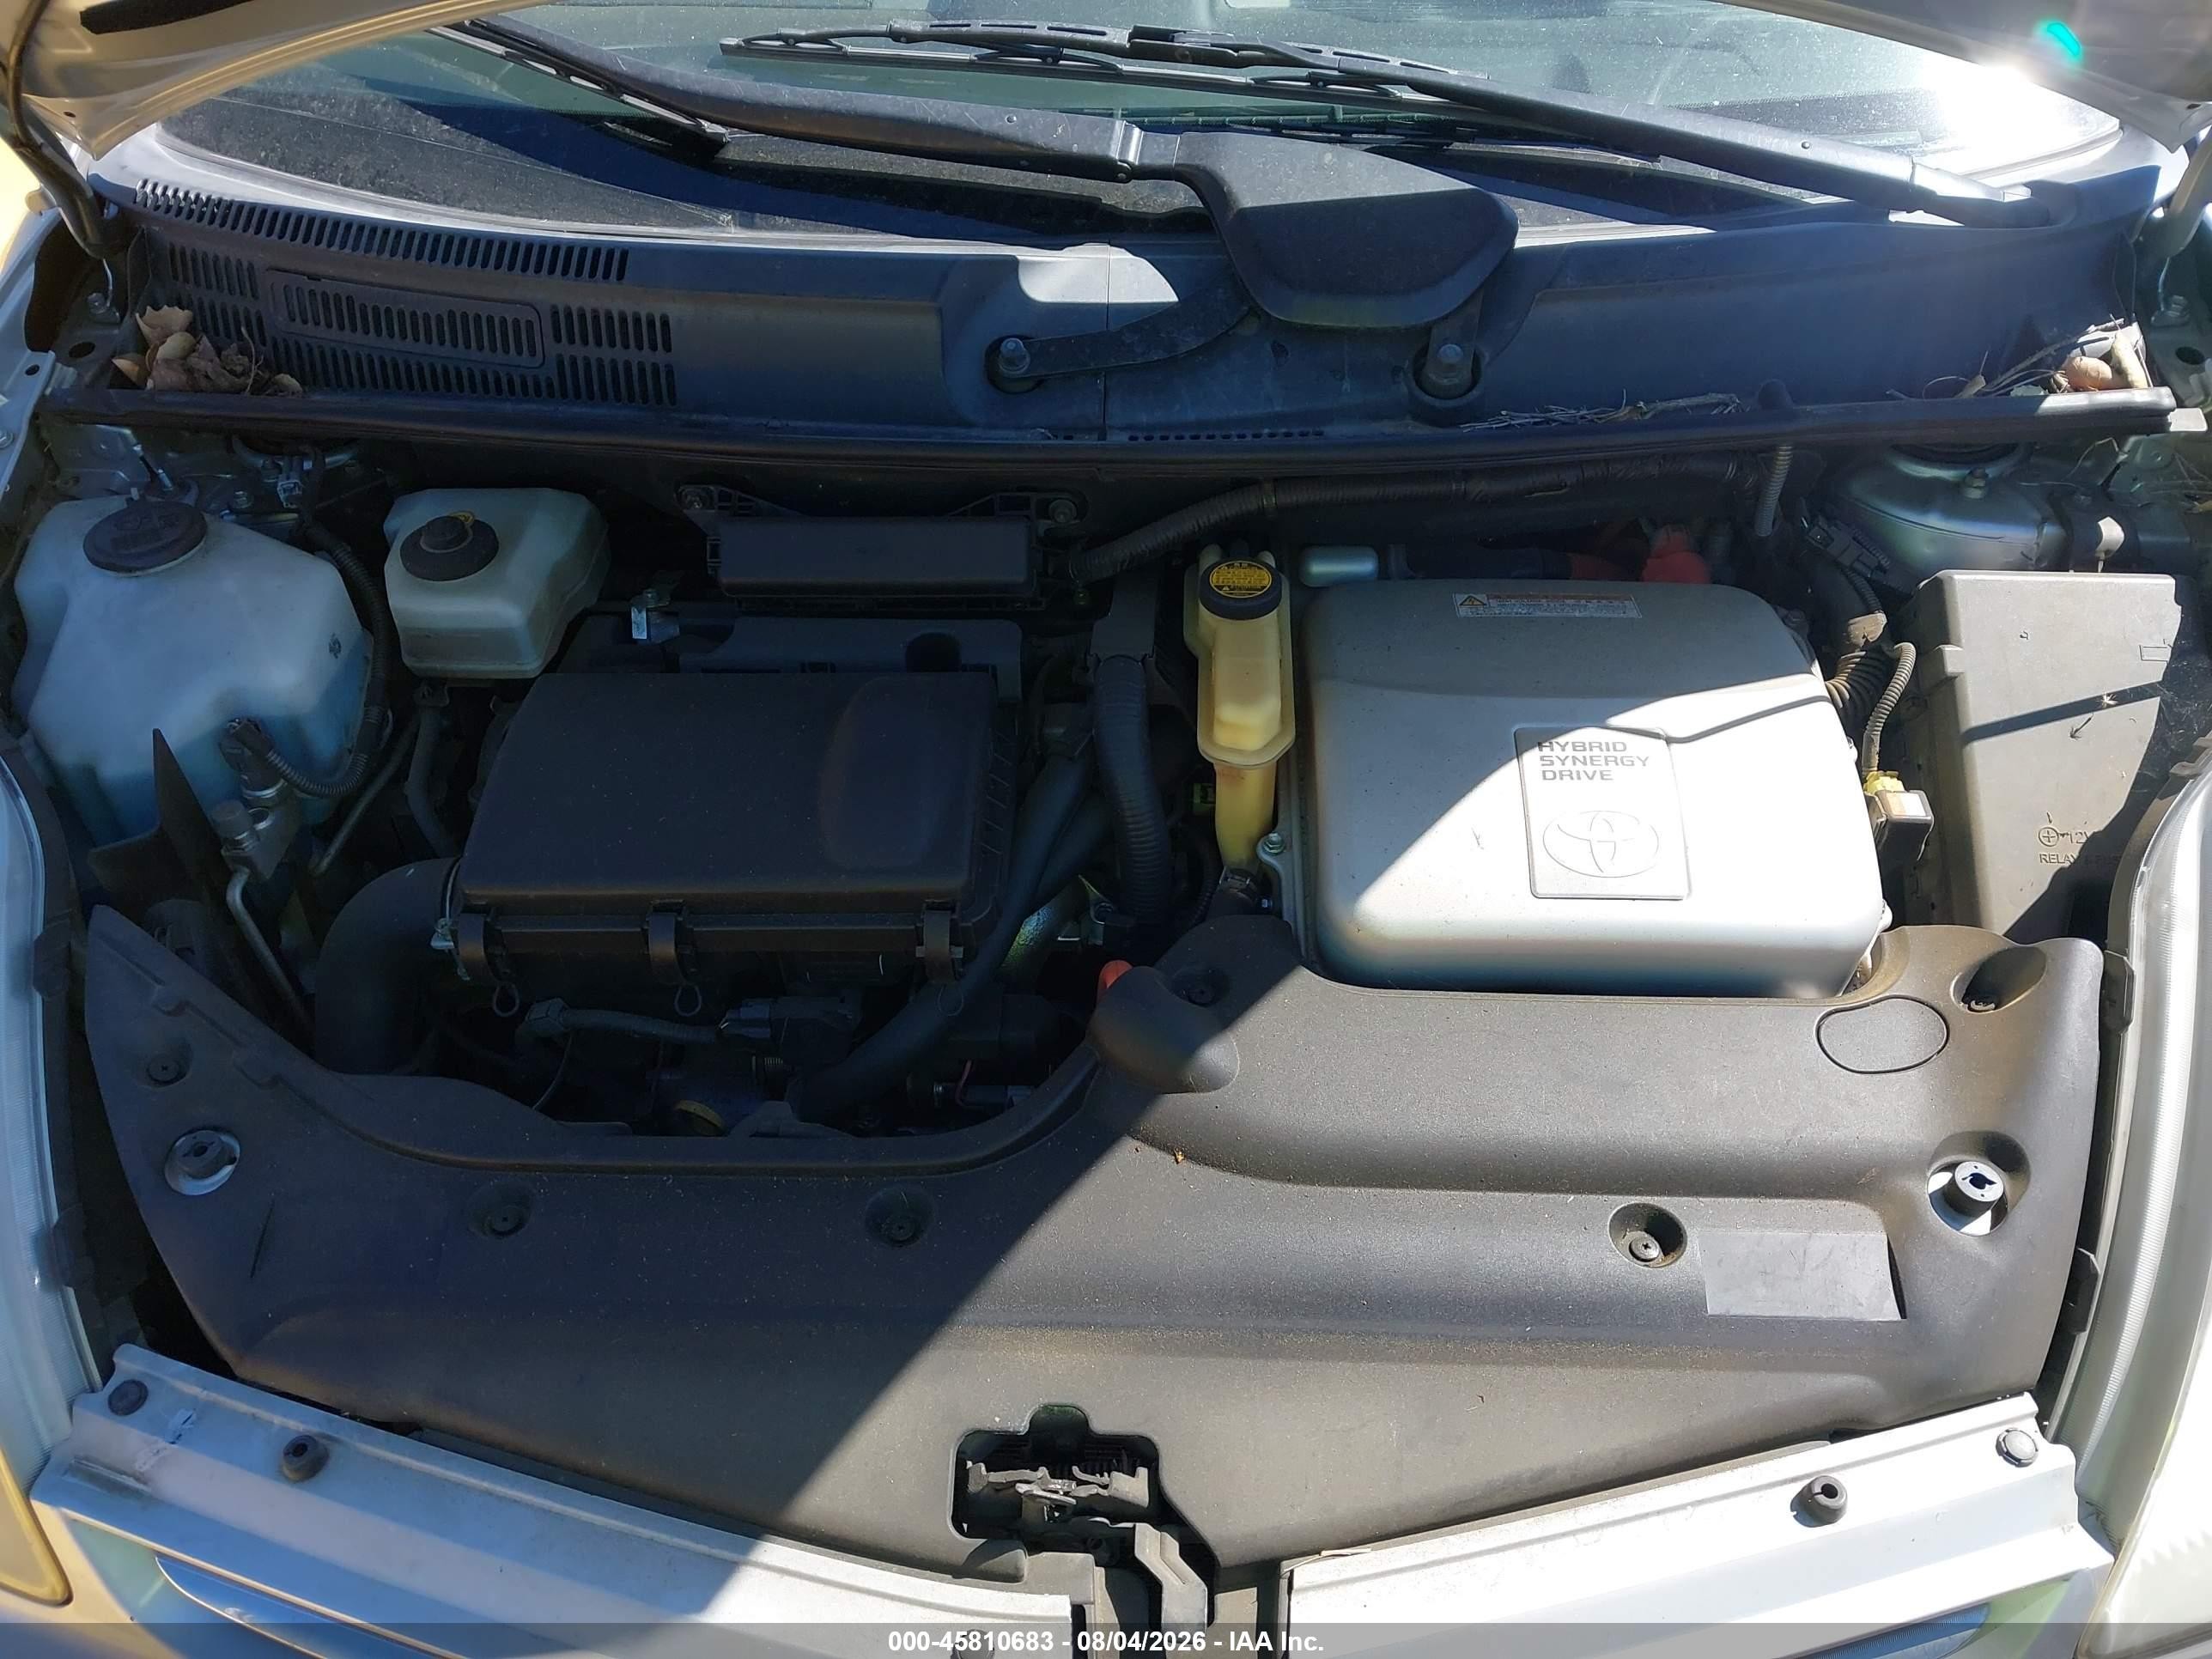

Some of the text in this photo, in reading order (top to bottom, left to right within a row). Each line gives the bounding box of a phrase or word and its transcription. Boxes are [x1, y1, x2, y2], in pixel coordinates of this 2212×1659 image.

[1538, 742, 1627, 752] HYBRID
[1540, 757, 1650, 767] SYNERGY
[1541, 770, 1615, 781] DRIVE
